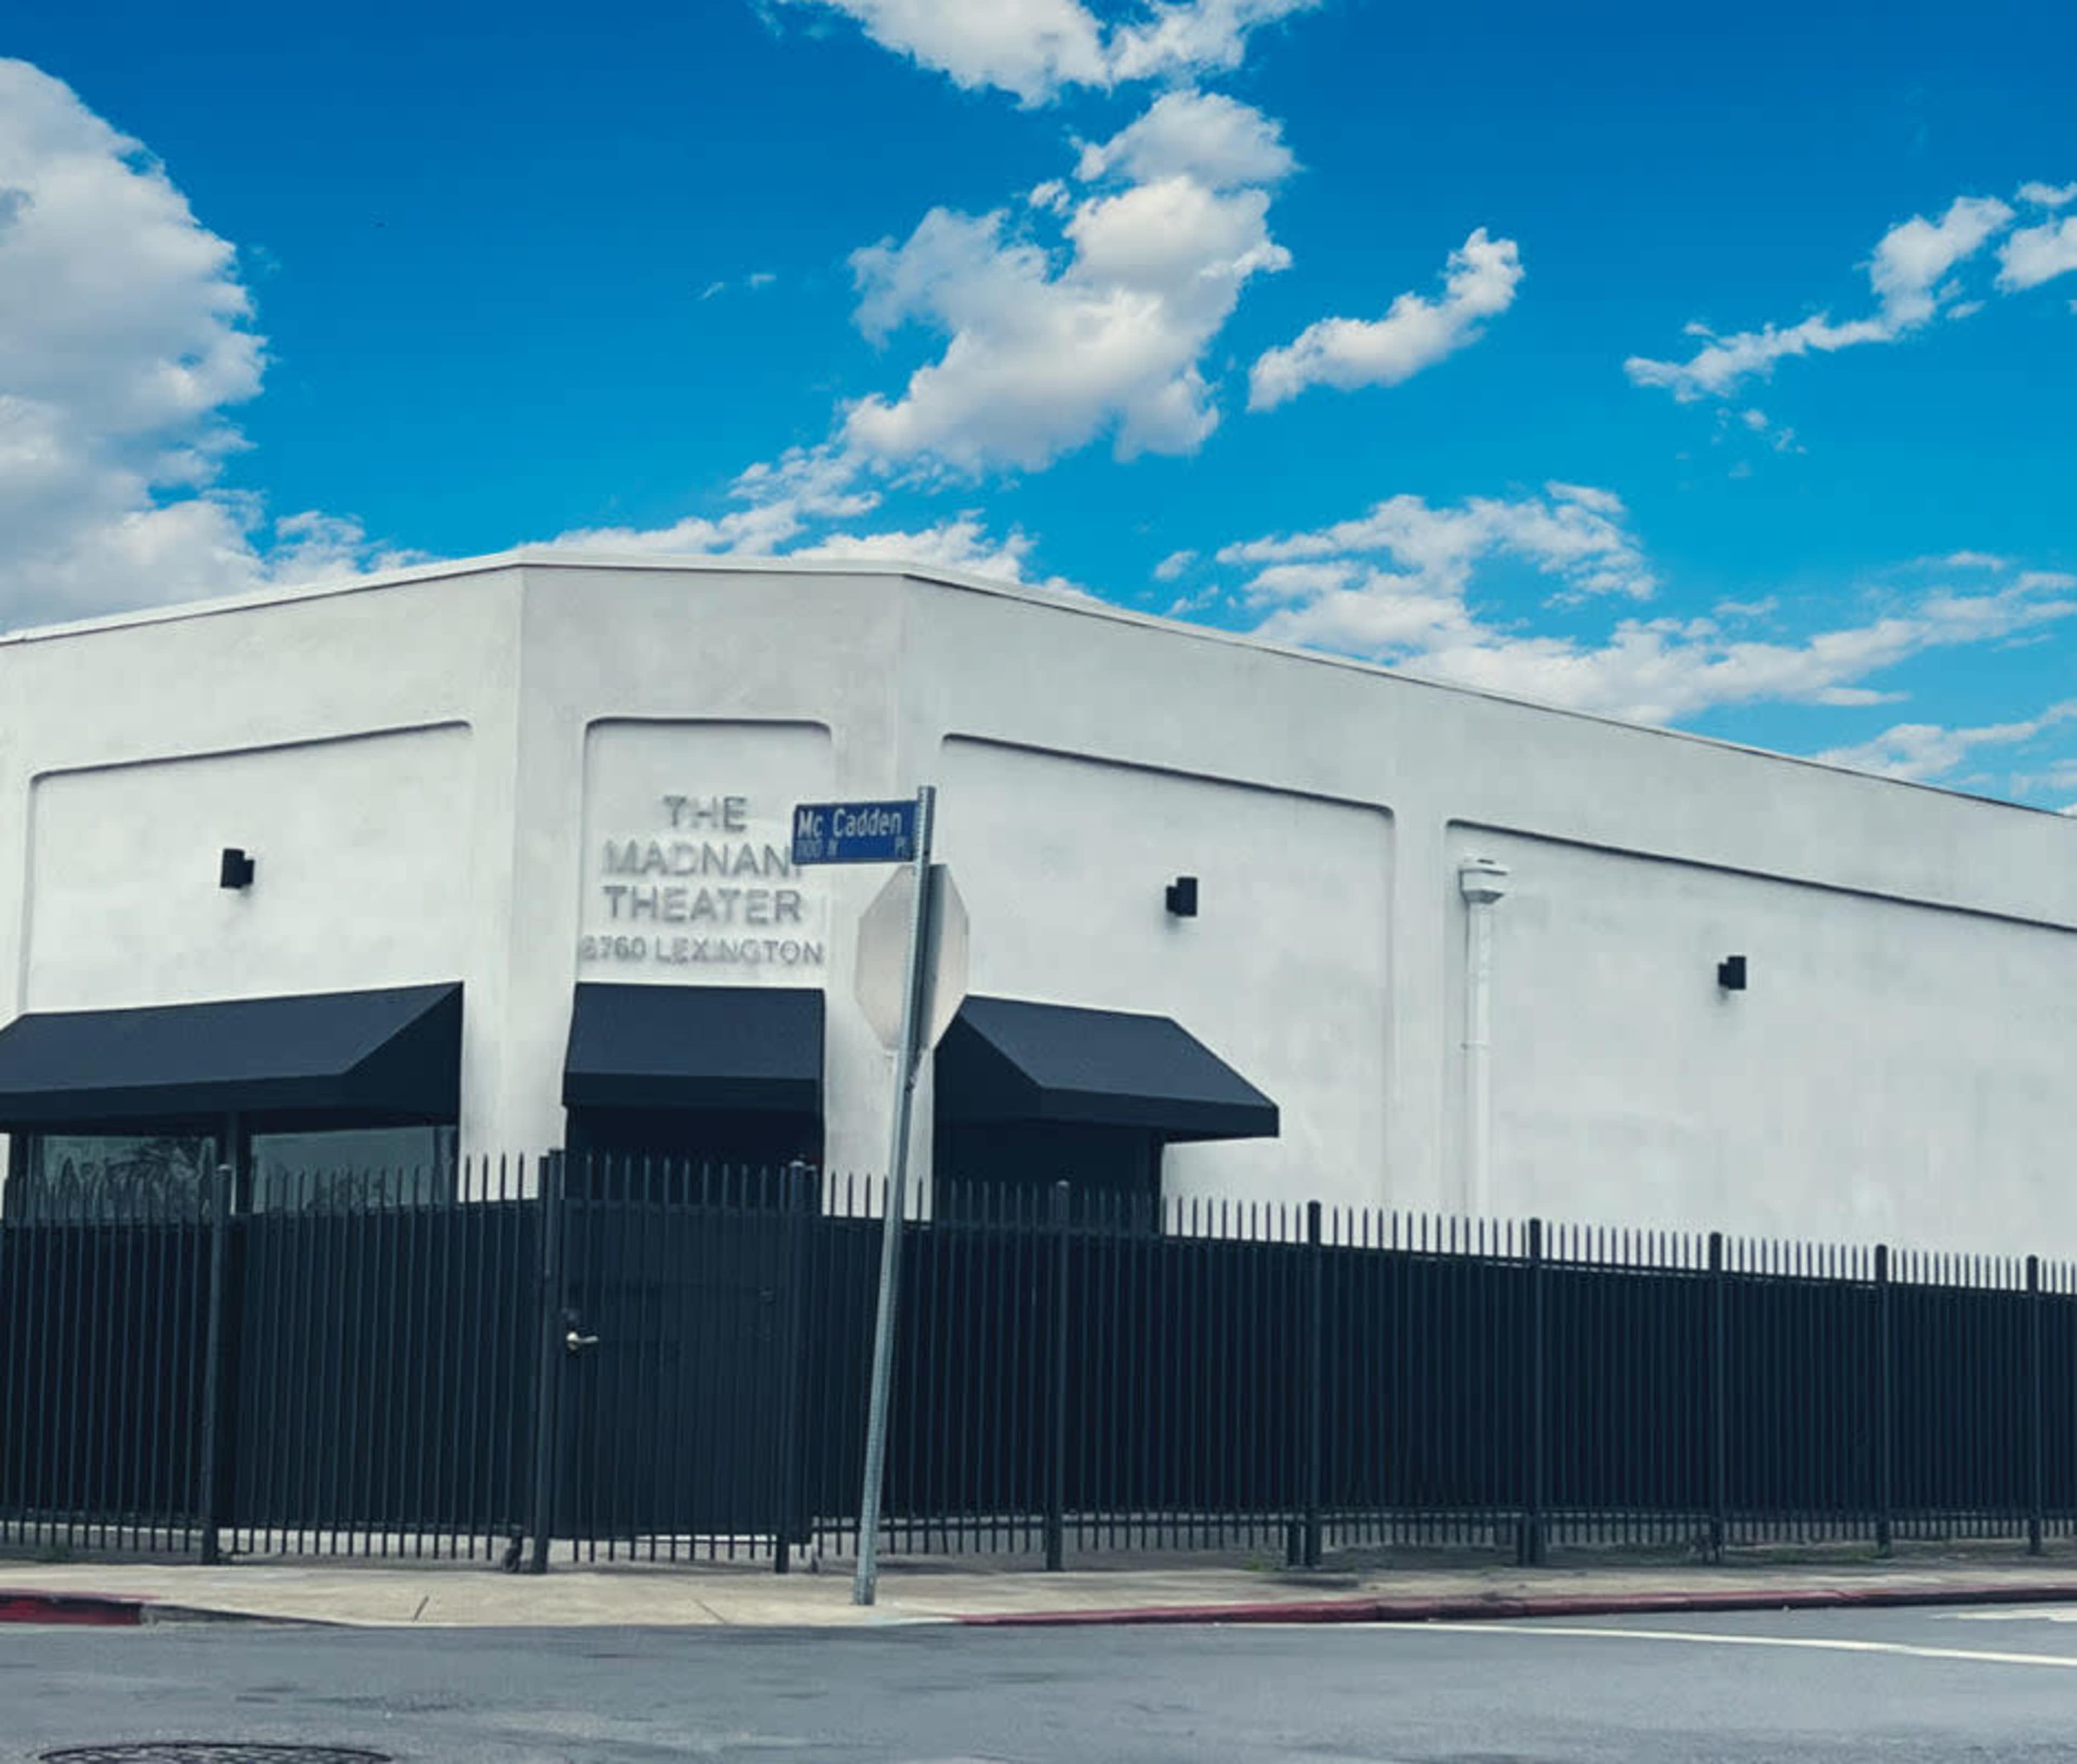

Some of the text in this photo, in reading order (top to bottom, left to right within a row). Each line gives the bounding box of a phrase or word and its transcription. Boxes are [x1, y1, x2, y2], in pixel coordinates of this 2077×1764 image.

[664, 796, 747, 833] THE
[797, 808, 902, 837] Mc Cadden
[601, 839, 802, 877] MADNAN
[602, 886, 803, 923] THEATER
[654, 935, 823, 965] LEXINGTON
